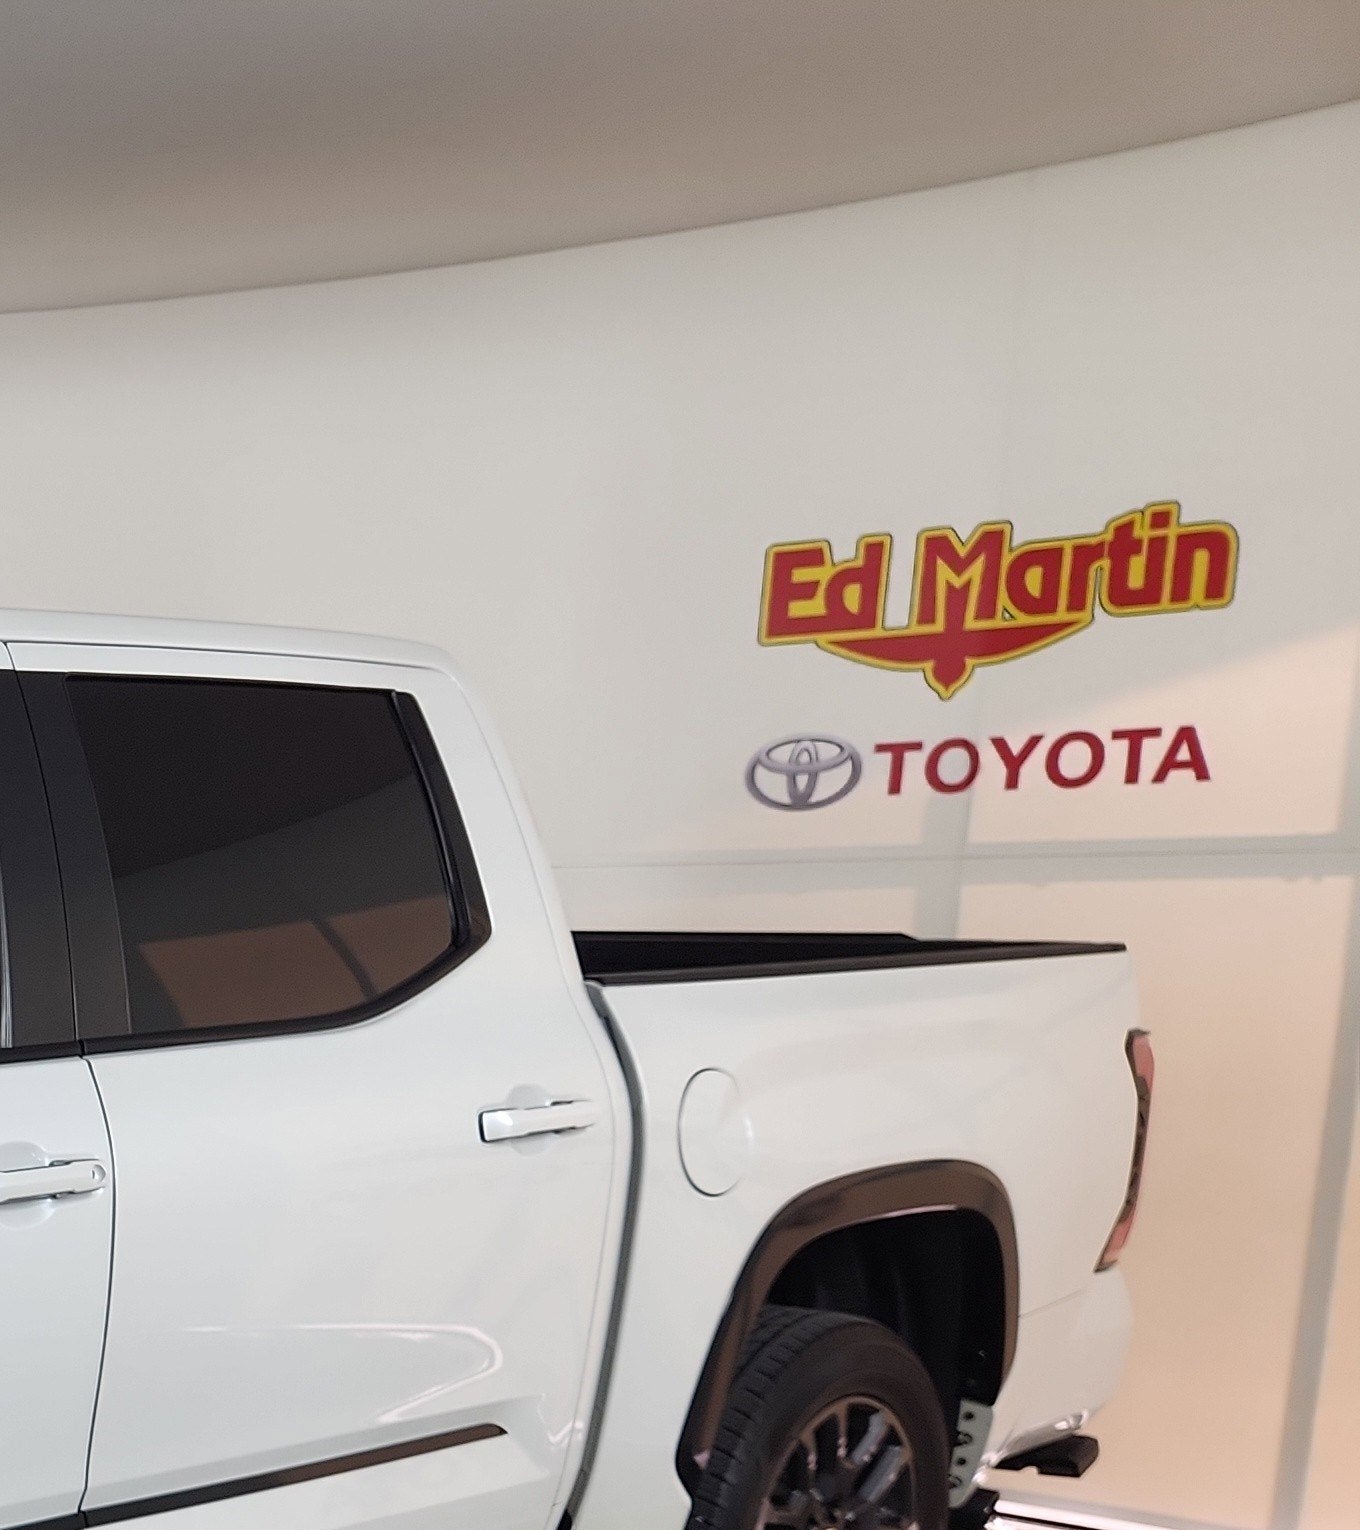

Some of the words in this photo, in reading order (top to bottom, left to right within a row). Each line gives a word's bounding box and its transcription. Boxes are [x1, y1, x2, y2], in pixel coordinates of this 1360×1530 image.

[764, 534, 886, 642] Ed
[913, 508, 1233, 627] Martin
[875, 725, 1212, 795] TOYOTA
